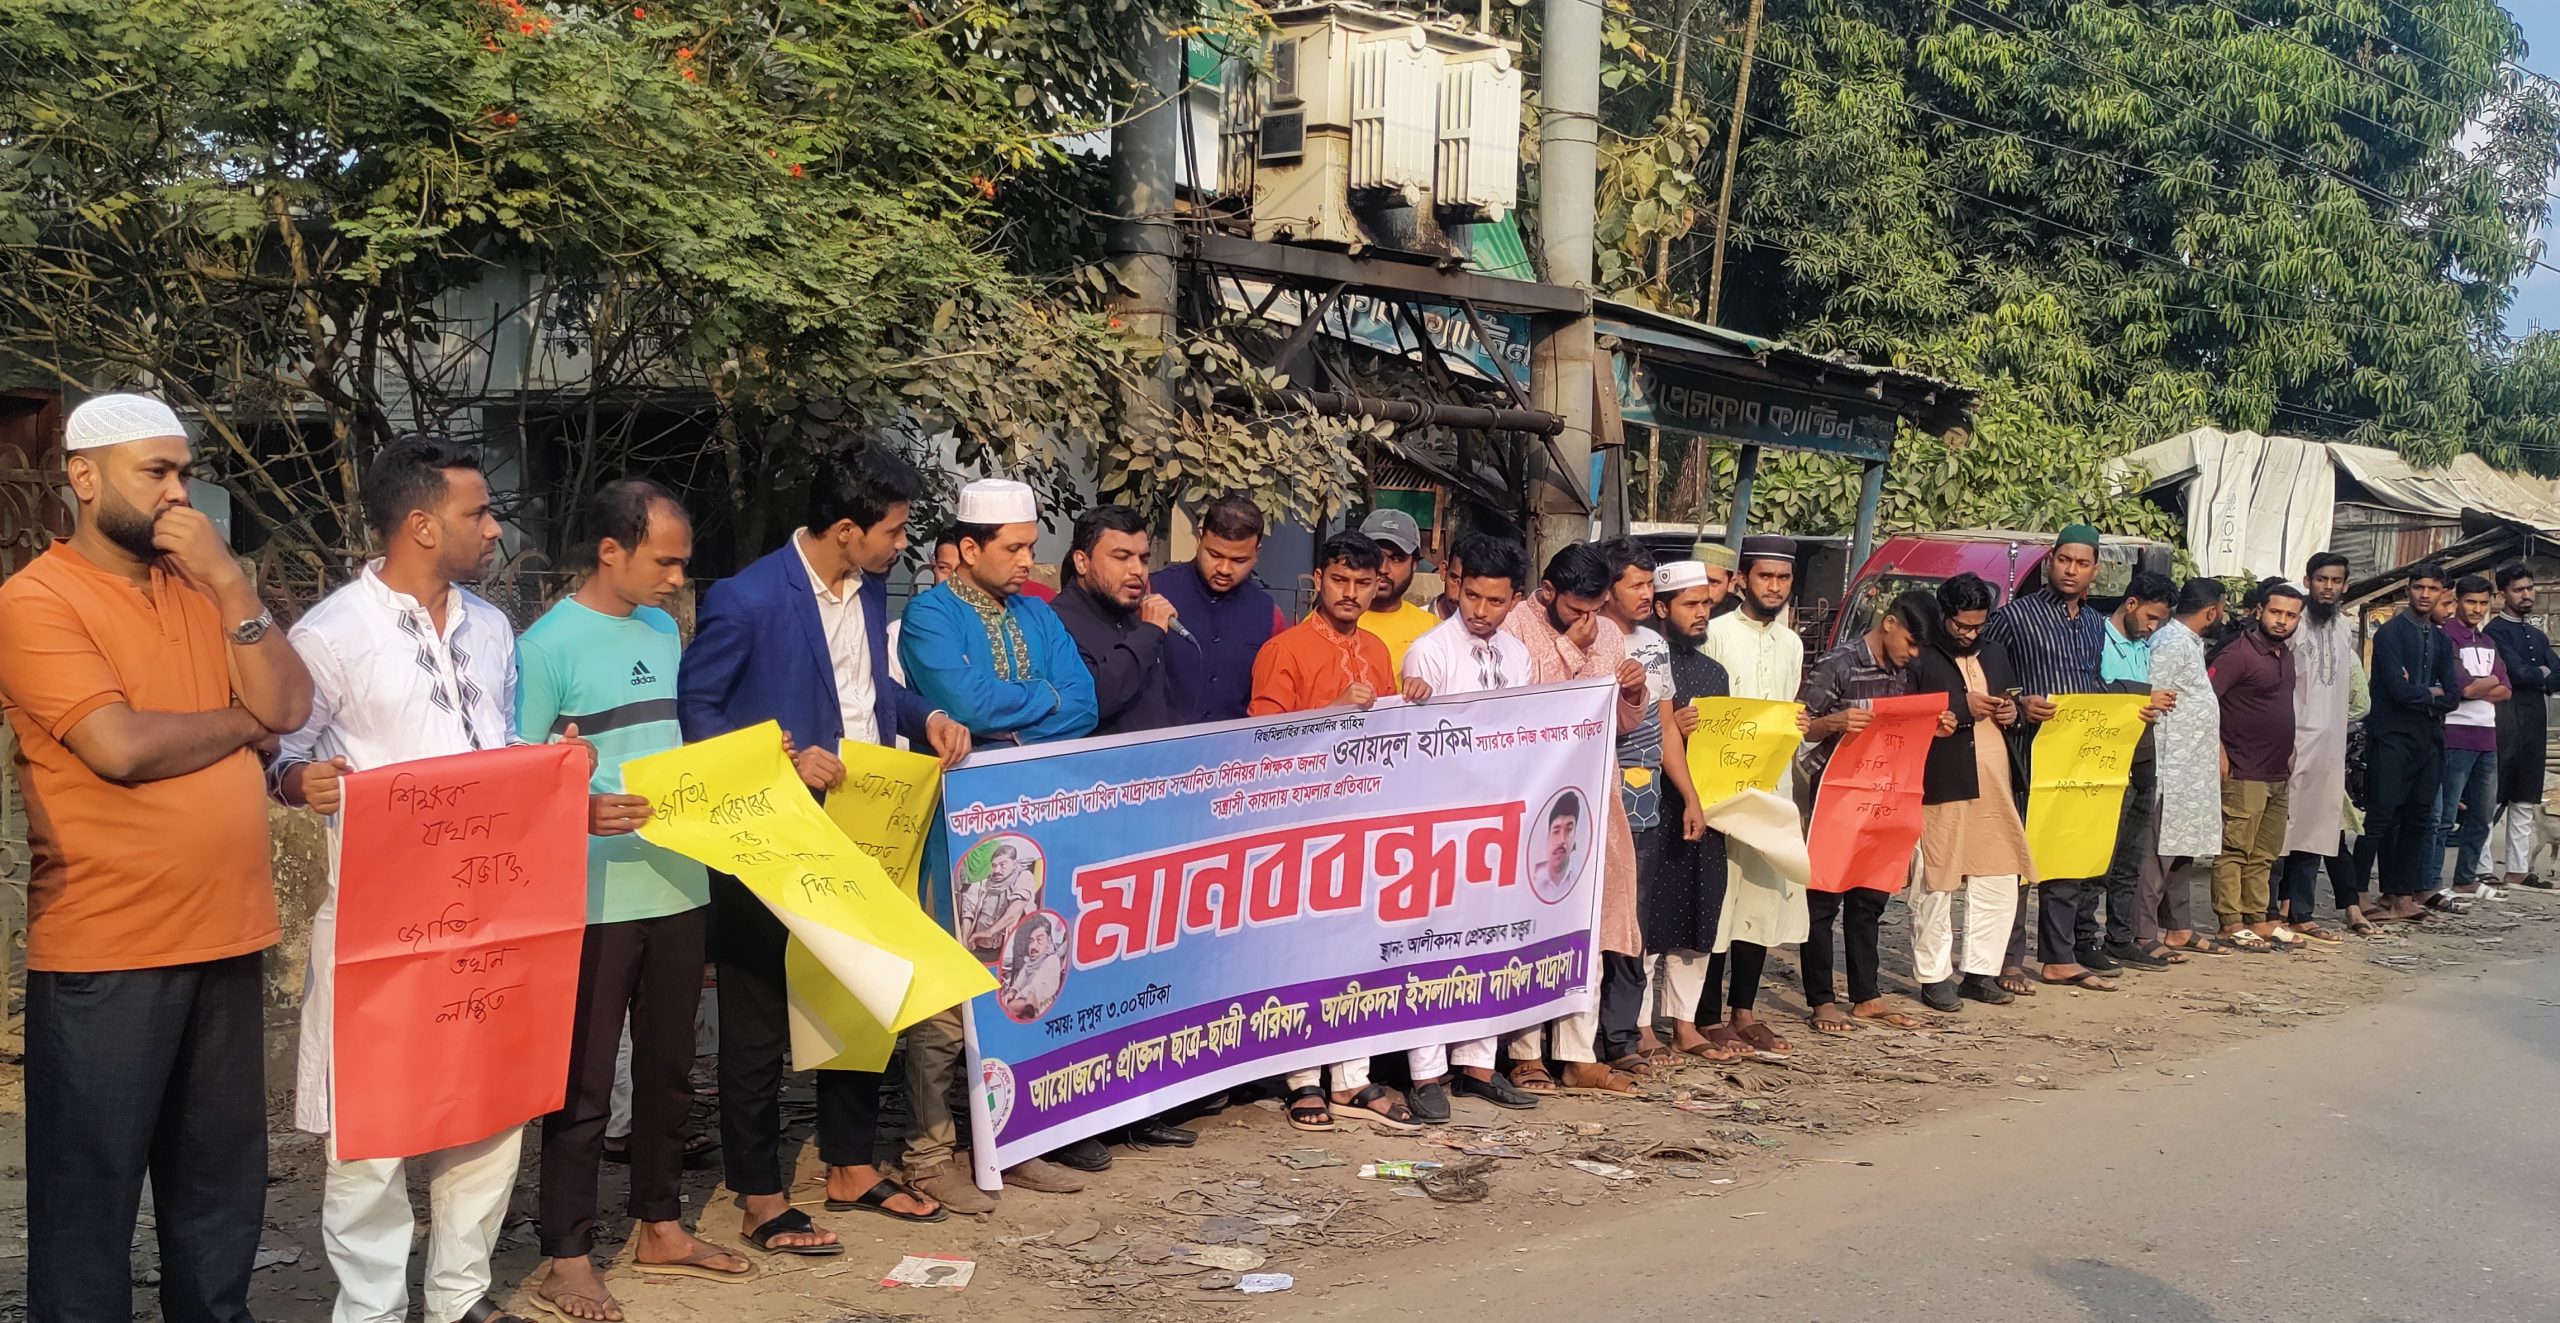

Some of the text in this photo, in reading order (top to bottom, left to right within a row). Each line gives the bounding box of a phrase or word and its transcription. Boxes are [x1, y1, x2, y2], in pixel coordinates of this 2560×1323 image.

[1768, 401, 1854, 440] ক্যান্টিন
[2222, 514, 2236, 554] IOM
[631, 676, 656, 686] adidas
[1301, 719, 1337, 736] রাহমানির
[1340, 715, 1365, 731] রাহিম
[1720, 744, 1757, 769] বিচার
[389, 772, 480, 815] শিক্ষক
[950, 797, 1016, 834] আলীকদম
[1020, 789, 1079, 823] ইসলামিয়া
[1082, 782, 1117, 811] দাখিল
[1120, 779, 1166, 803] মাদ্রাসার
[1170, 767, 1214, 794] সম্মানিত
[1218, 763, 1255, 787] সিনিয়র
[1259, 757, 1293, 780] শিক্ষক
[1297, 753, 1328, 772] জনাব
[1332, 729, 1412, 769] ওবায়দুল
[1417, 719, 1473, 761] হাকিম
[1517, 726, 1537, 746] নিজ
[1540, 725, 1568, 743] খামার
[1571, 719, 1604, 741] বাড়িতে
[1212, 775, 1382, 821] সন্ত্রাসী কায়দায় হামলার প্রতিবাদে
[423, 812, 509, 846] যখন
[1076, 800, 1527, 965] মানববন্ধন
[398, 902, 479, 952] জাতি
[1407, 928, 1462, 954] আলীকদম
[1465, 924, 1508, 947] প্রেসক্লাব
[450, 947, 520, 975] তখন
[1077, 1004, 1104, 1034] দুপুর
[1116, 1033, 1167, 1084] প্রাক্তন
[1170, 1003, 1246, 1068] ছাত্র-ছাত্রী
[1249, 996, 1312, 1041] পরিষদ,
[1320, 980, 1403, 1029] আলীকদম
[1405, 965, 1487, 1017] ইসলামিয়া
[1490, 956, 1532, 1002] দাখিল
